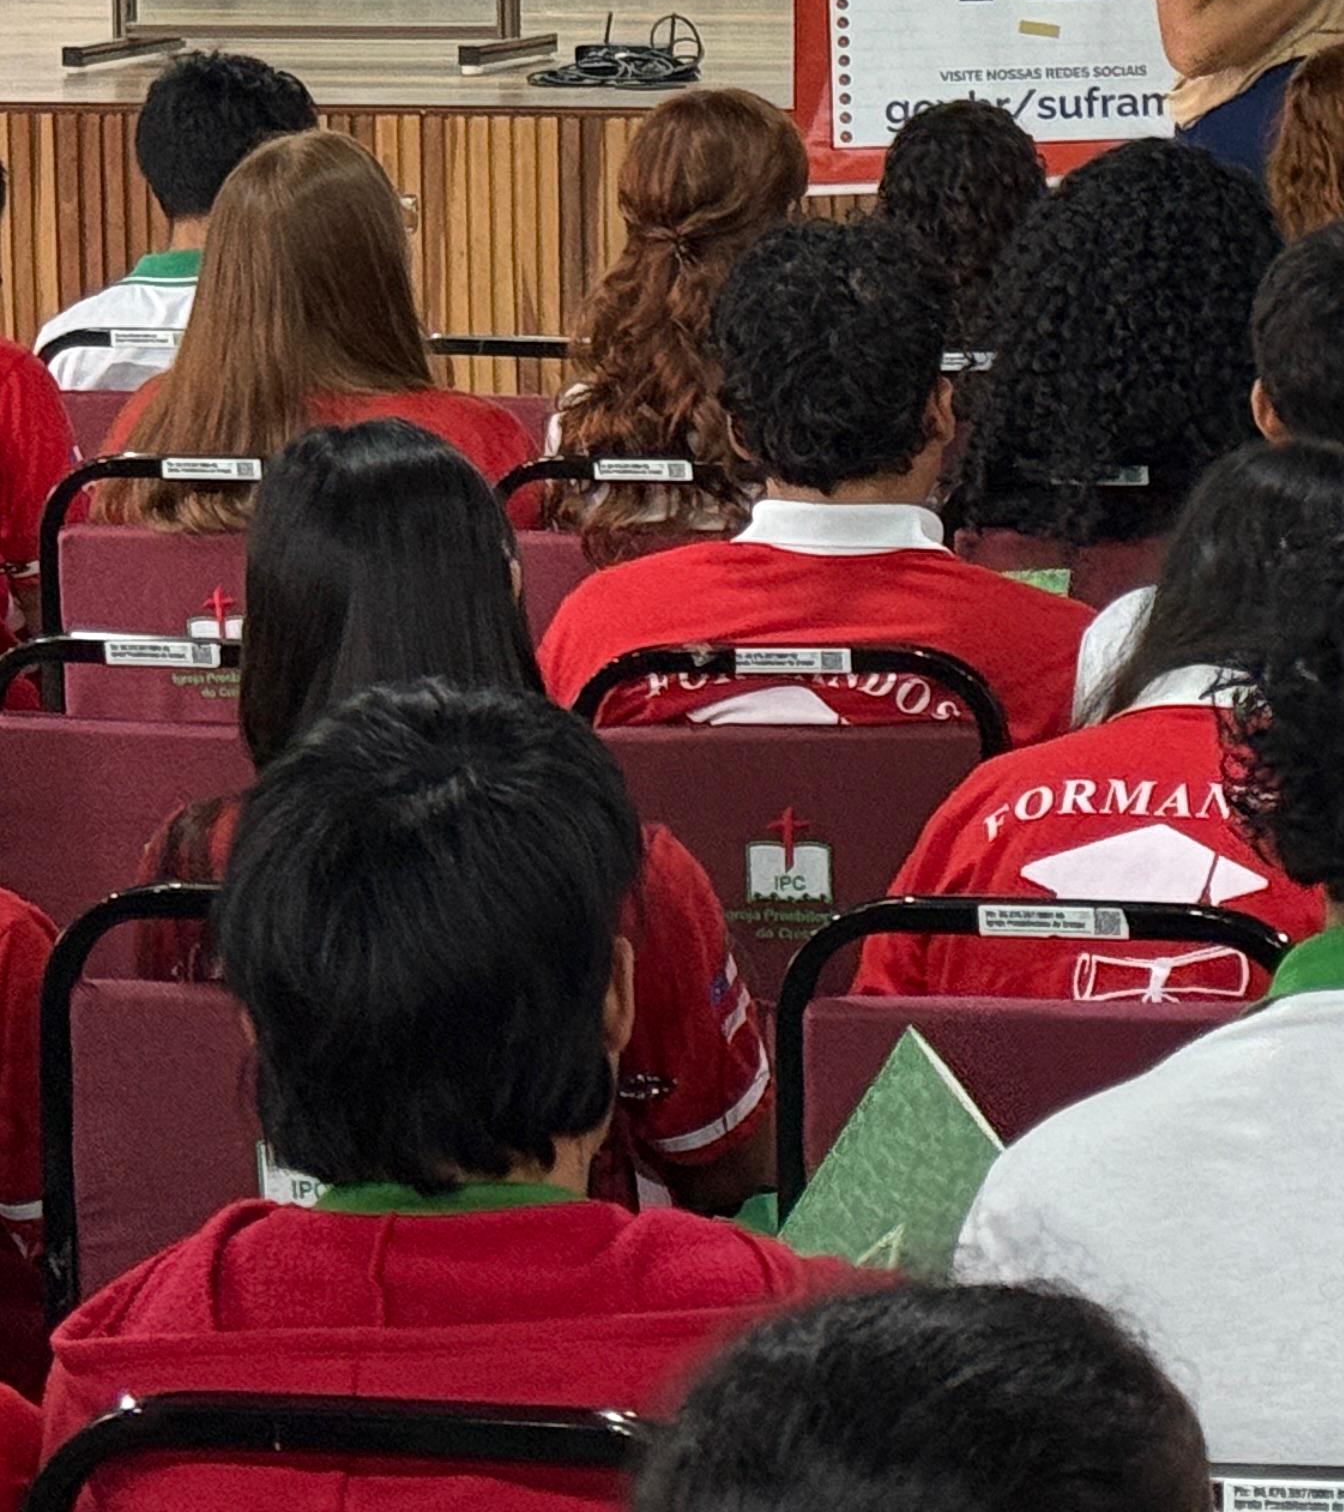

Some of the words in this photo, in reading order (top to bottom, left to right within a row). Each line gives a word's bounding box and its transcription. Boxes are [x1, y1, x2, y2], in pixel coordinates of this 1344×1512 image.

[939, 69, 983, 82] VISITE
[986, 67, 1042, 81] NOSSAS
[1045, 66, 1090, 80] REDES
[1092, 64, 1148, 78] SOCIAIS
[983, 778, 1232, 843] FORMAN
[774, 874, 806, 892] IPC
